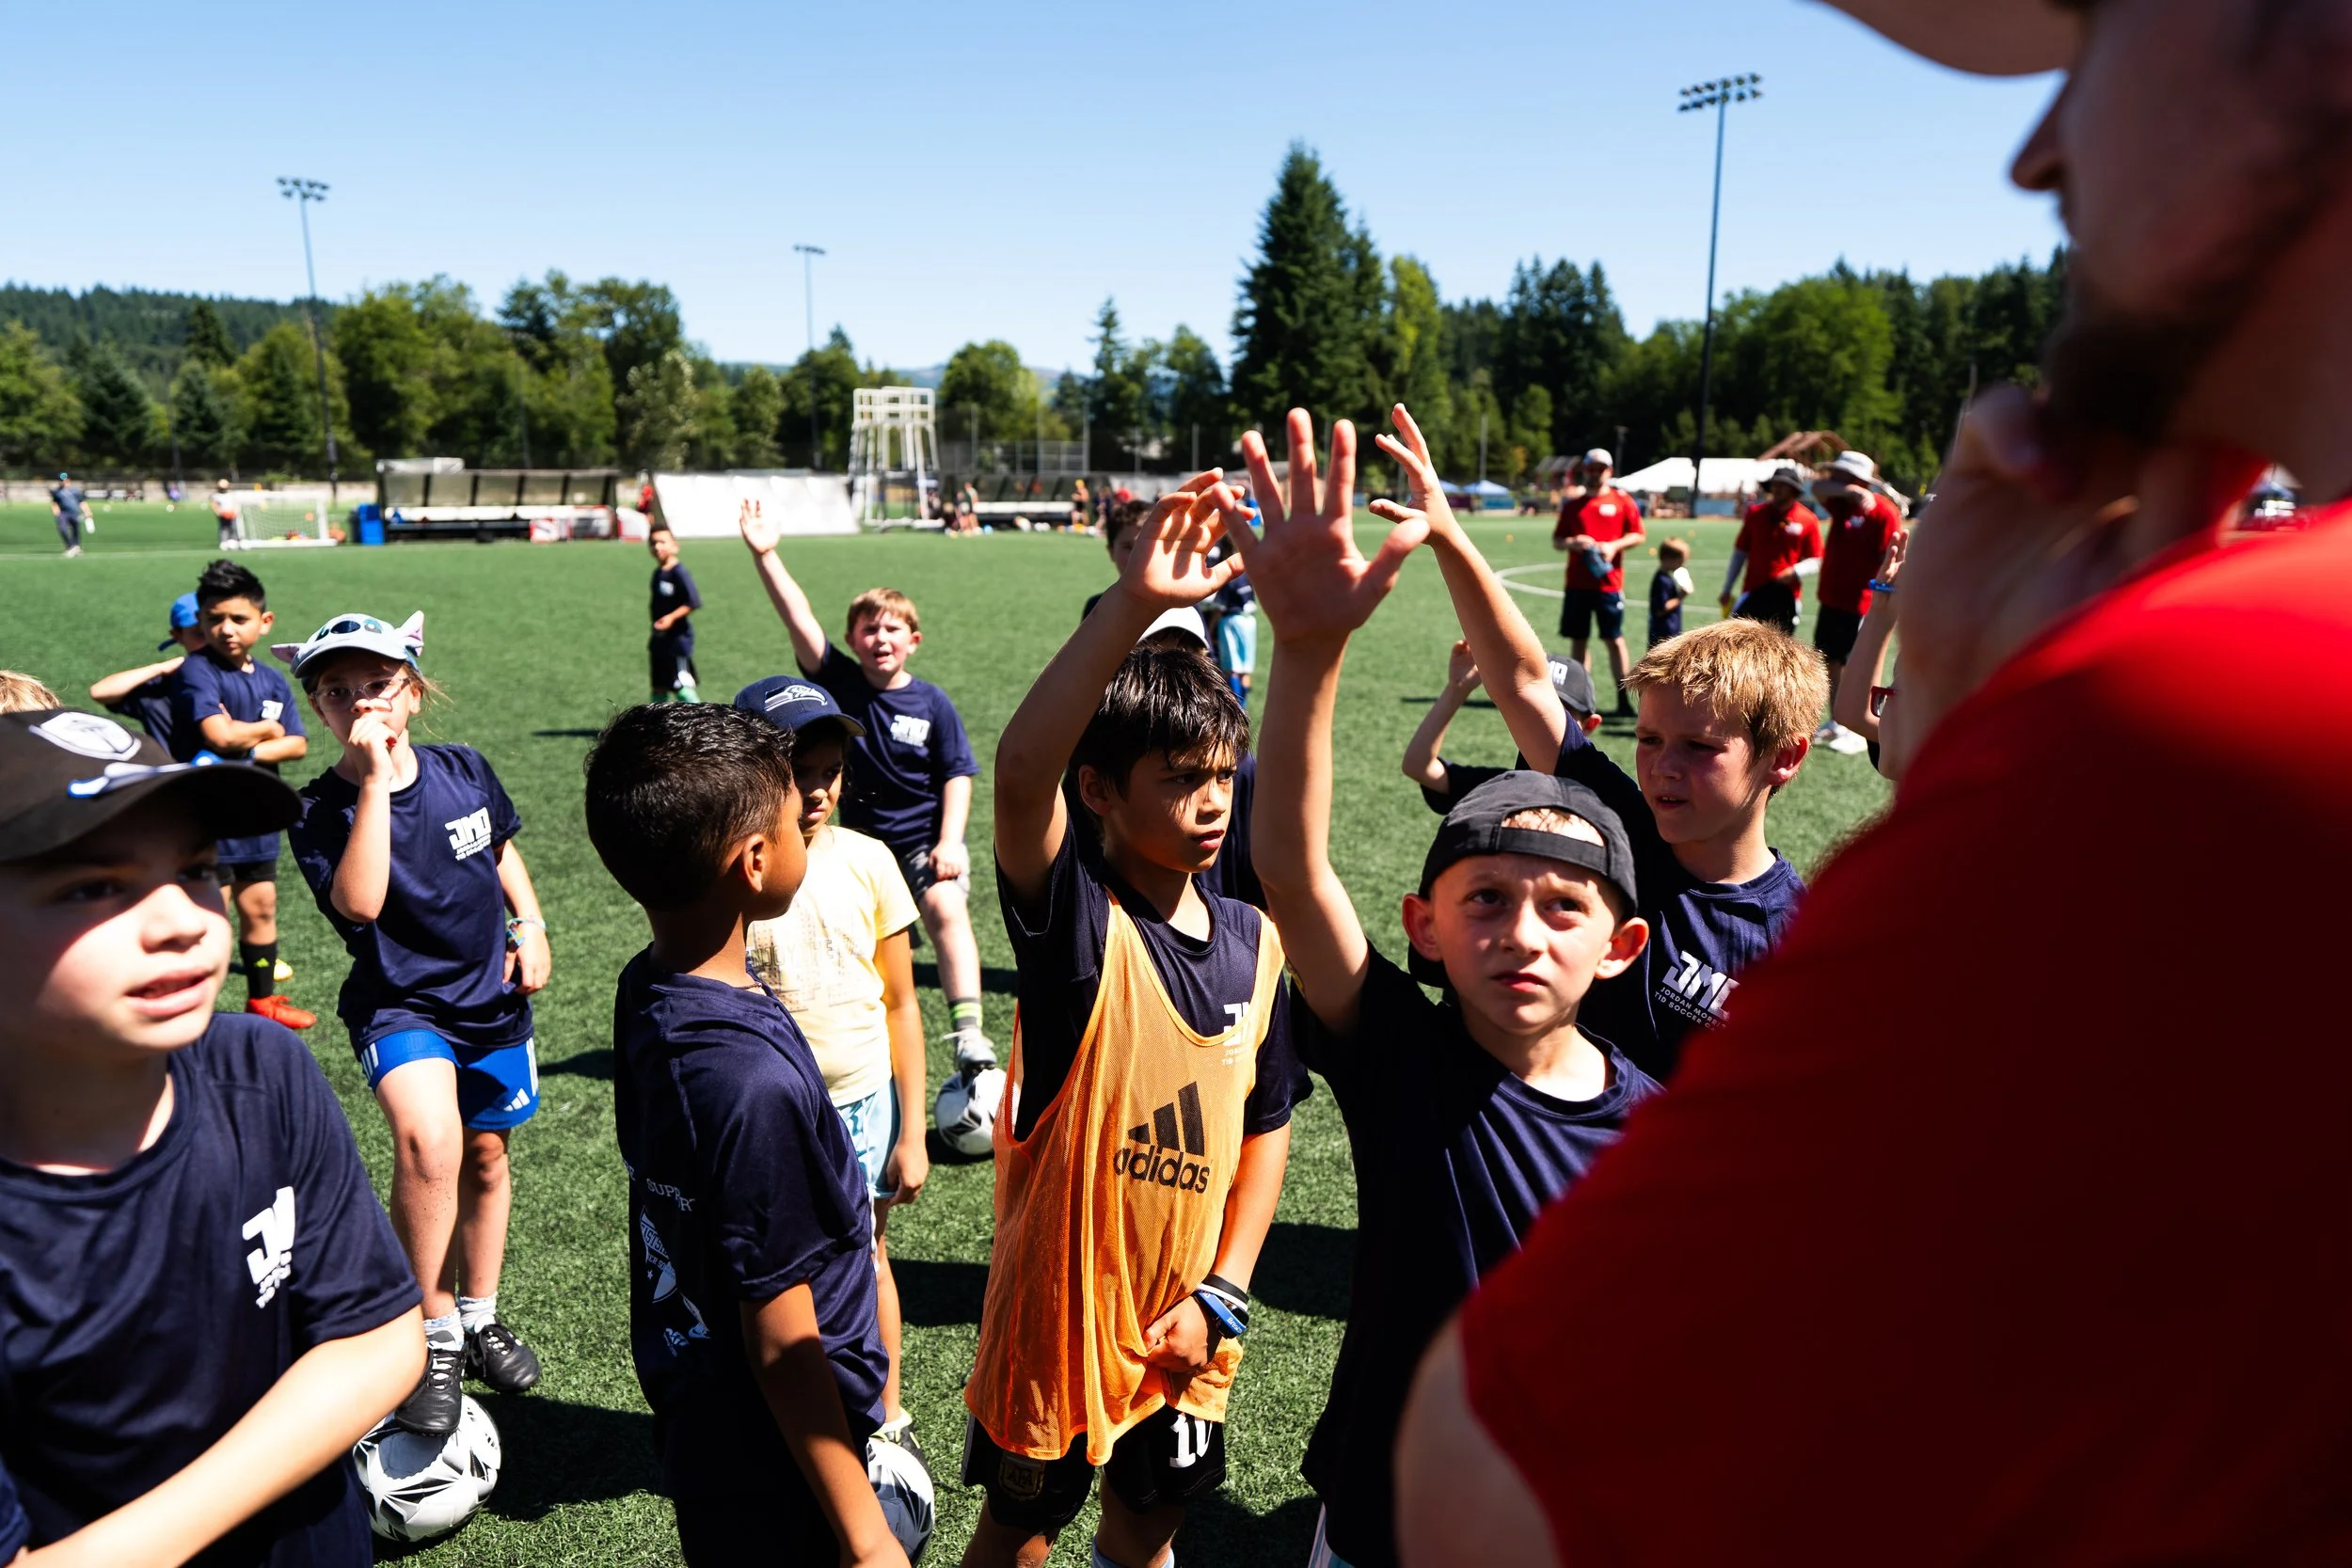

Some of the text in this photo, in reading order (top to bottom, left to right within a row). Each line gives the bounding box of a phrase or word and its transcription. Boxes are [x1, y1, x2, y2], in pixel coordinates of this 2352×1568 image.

[1661, 986, 1692, 1010] JORDAN
[1668, 1001, 1703, 1024] SOCCER
[1113, 1145, 1211, 1195] adidas
